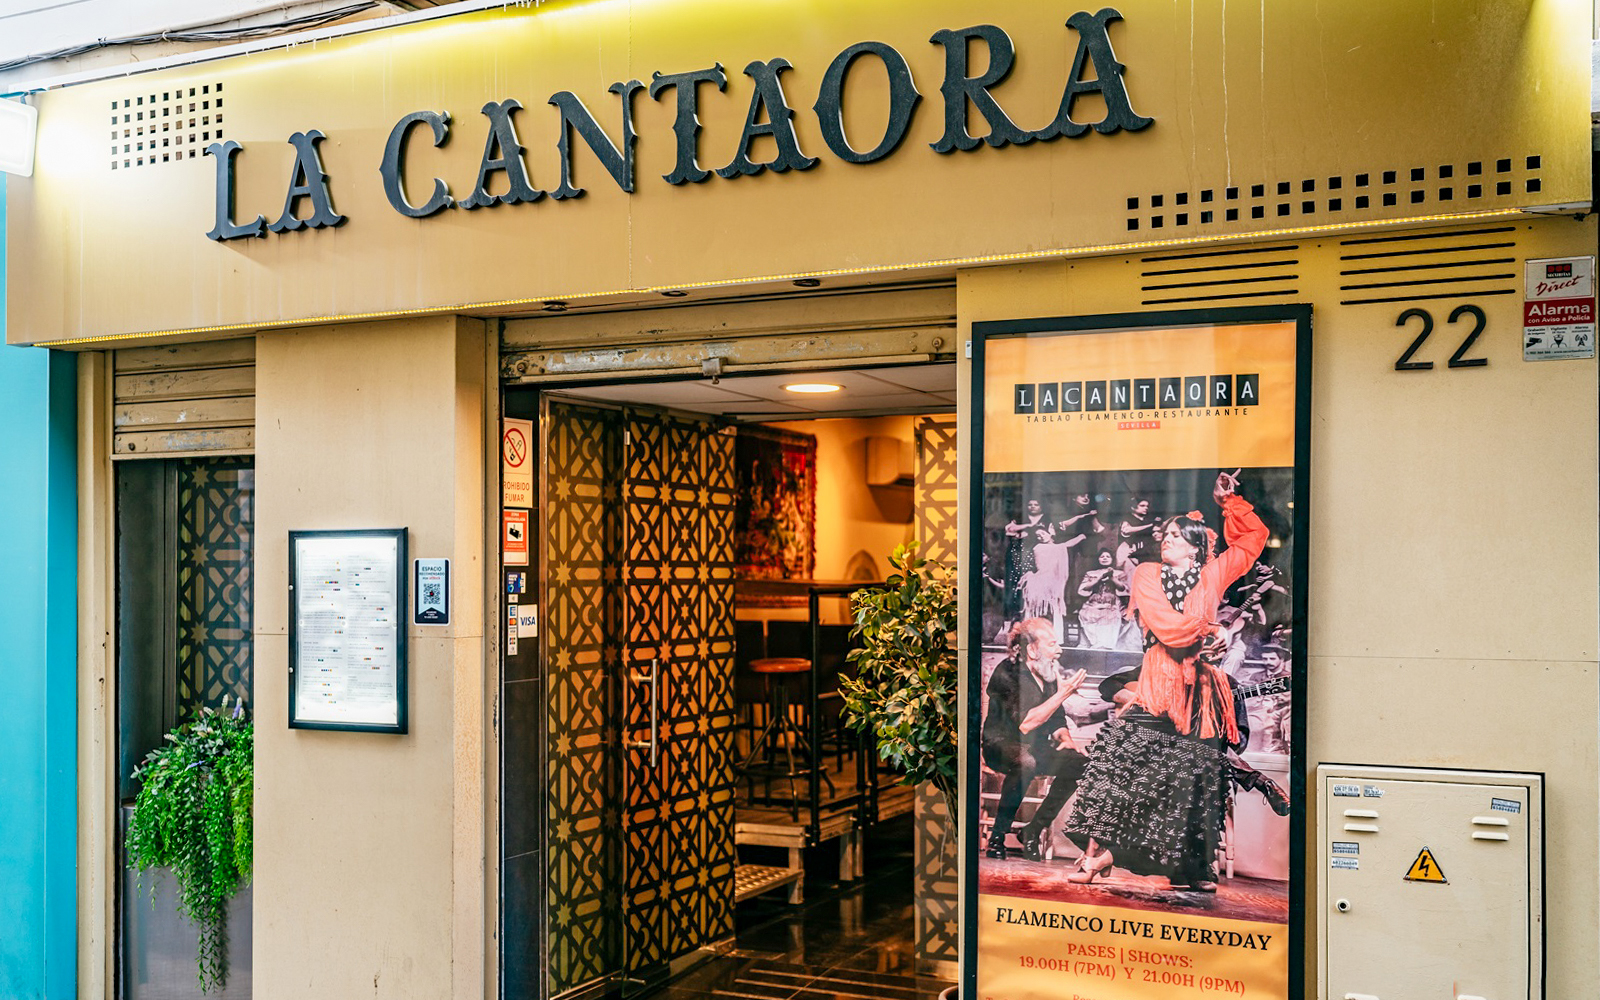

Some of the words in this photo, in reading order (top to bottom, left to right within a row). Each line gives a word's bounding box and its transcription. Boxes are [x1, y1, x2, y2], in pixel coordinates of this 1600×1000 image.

[205, 129, 349, 242] LA
[379, 7, 1155, 219] CANTAORA
[1535, 274, 1585, 296] Direct
[1528, 303, 1591, 316] Alarma
[1568, 313, 1591, 321] Policía
[1395, 304, 1488, 371] 22
[1027, 415, 1071, 423] TABLAO
[1120, 421, 1157, 429] SEVILLA
[503, 482, 530, 491] ROHIBIDO
[505, 493, 525, 503] FUMAR
[520, 616, 536, 626] VISA
[996, 907, 1103, 932] FLAMENCO
[1109, 918, 1154, 938] LIVE
[1160, 925, 1272, 951] EVERYDAY
[1067, 943, 1116, 959] PASES
[1128, 949, 1193, 968] SHOWS:
[1019, 956, 1069, 972] 19.00H
[1074, 960, 1116, 979] (7PM)
[1124, 967, 1135, 980] Y
[1143, 970, 1195, 988] 21.00H
[1199, 975, 1246, 997] (9PM)
